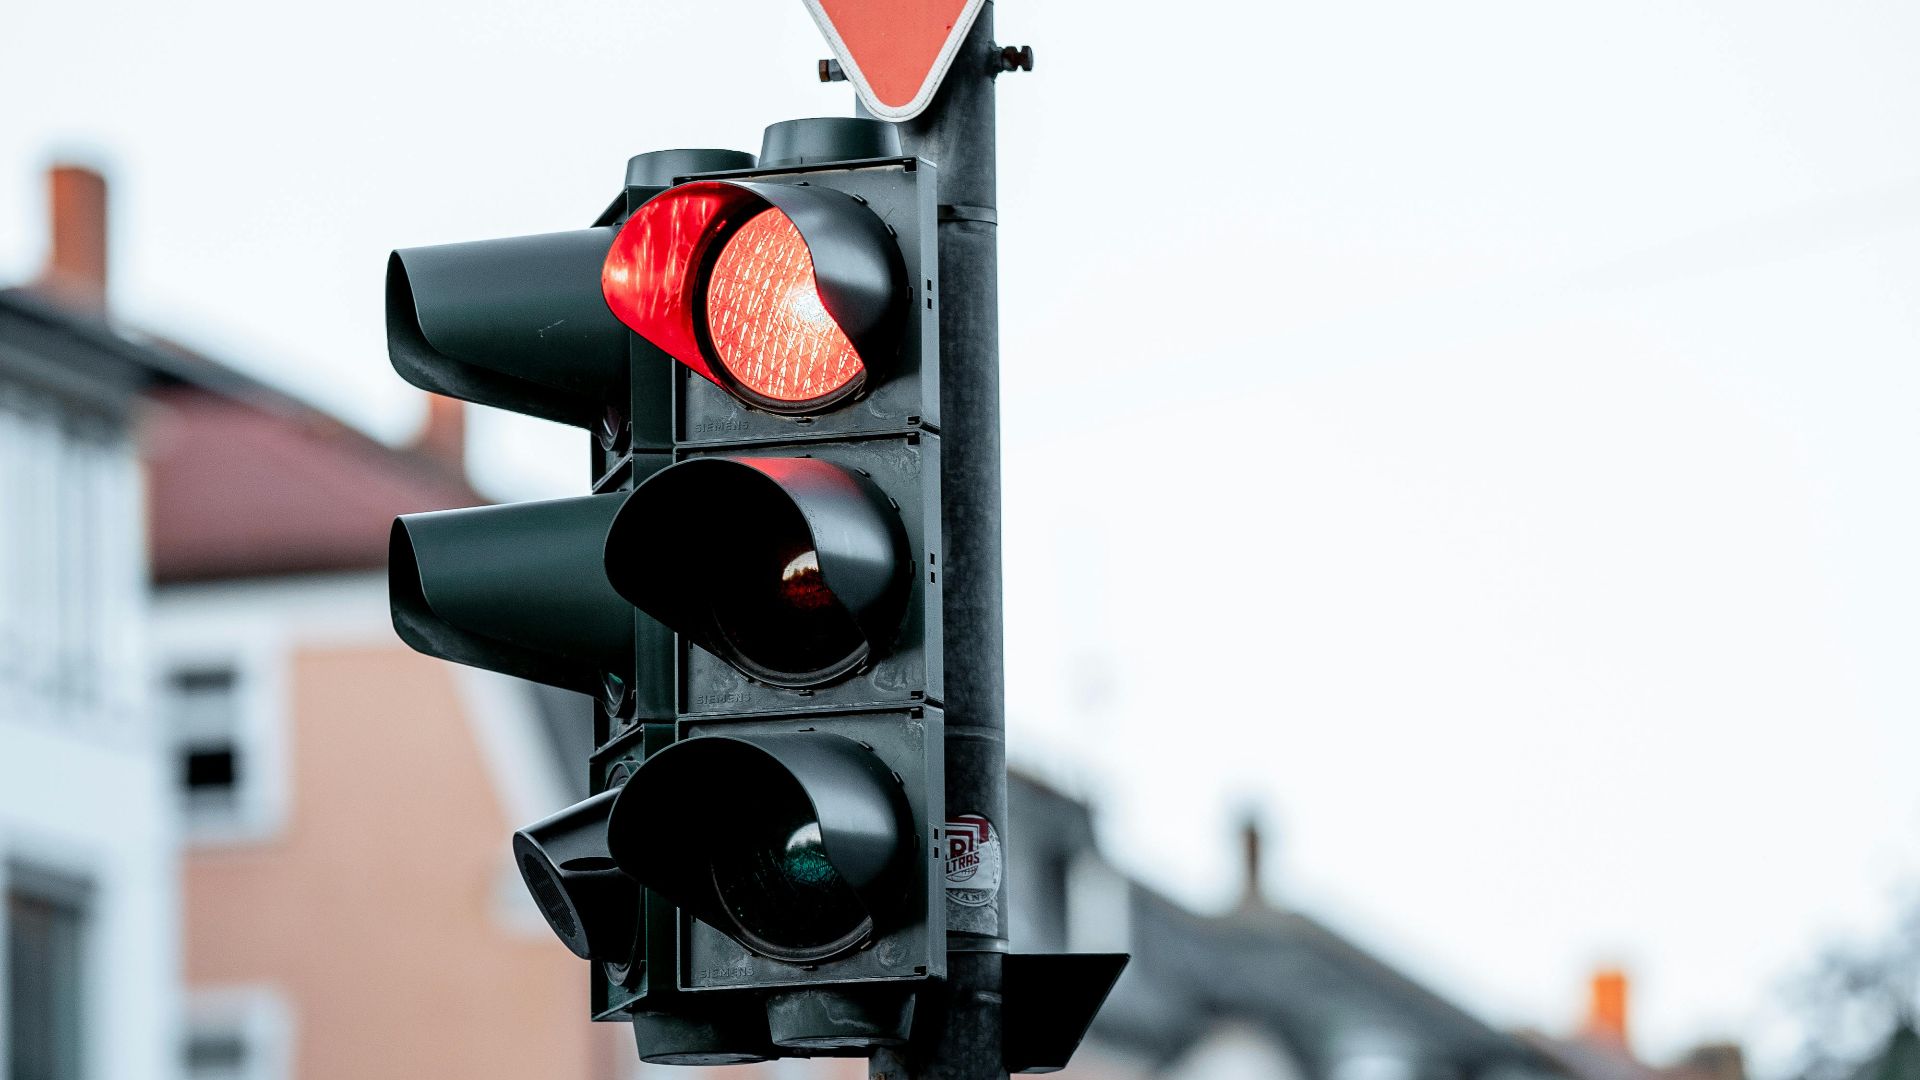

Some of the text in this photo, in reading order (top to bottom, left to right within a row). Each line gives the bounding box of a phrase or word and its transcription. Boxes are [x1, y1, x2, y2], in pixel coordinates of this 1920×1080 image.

[695, 421, 749, 433] SIEMENS
[697, 693, 751, 704] SIEMENS
[945, 853, 980, 874] LTRAS
[700, 967, 755, 978] SIEMENS
